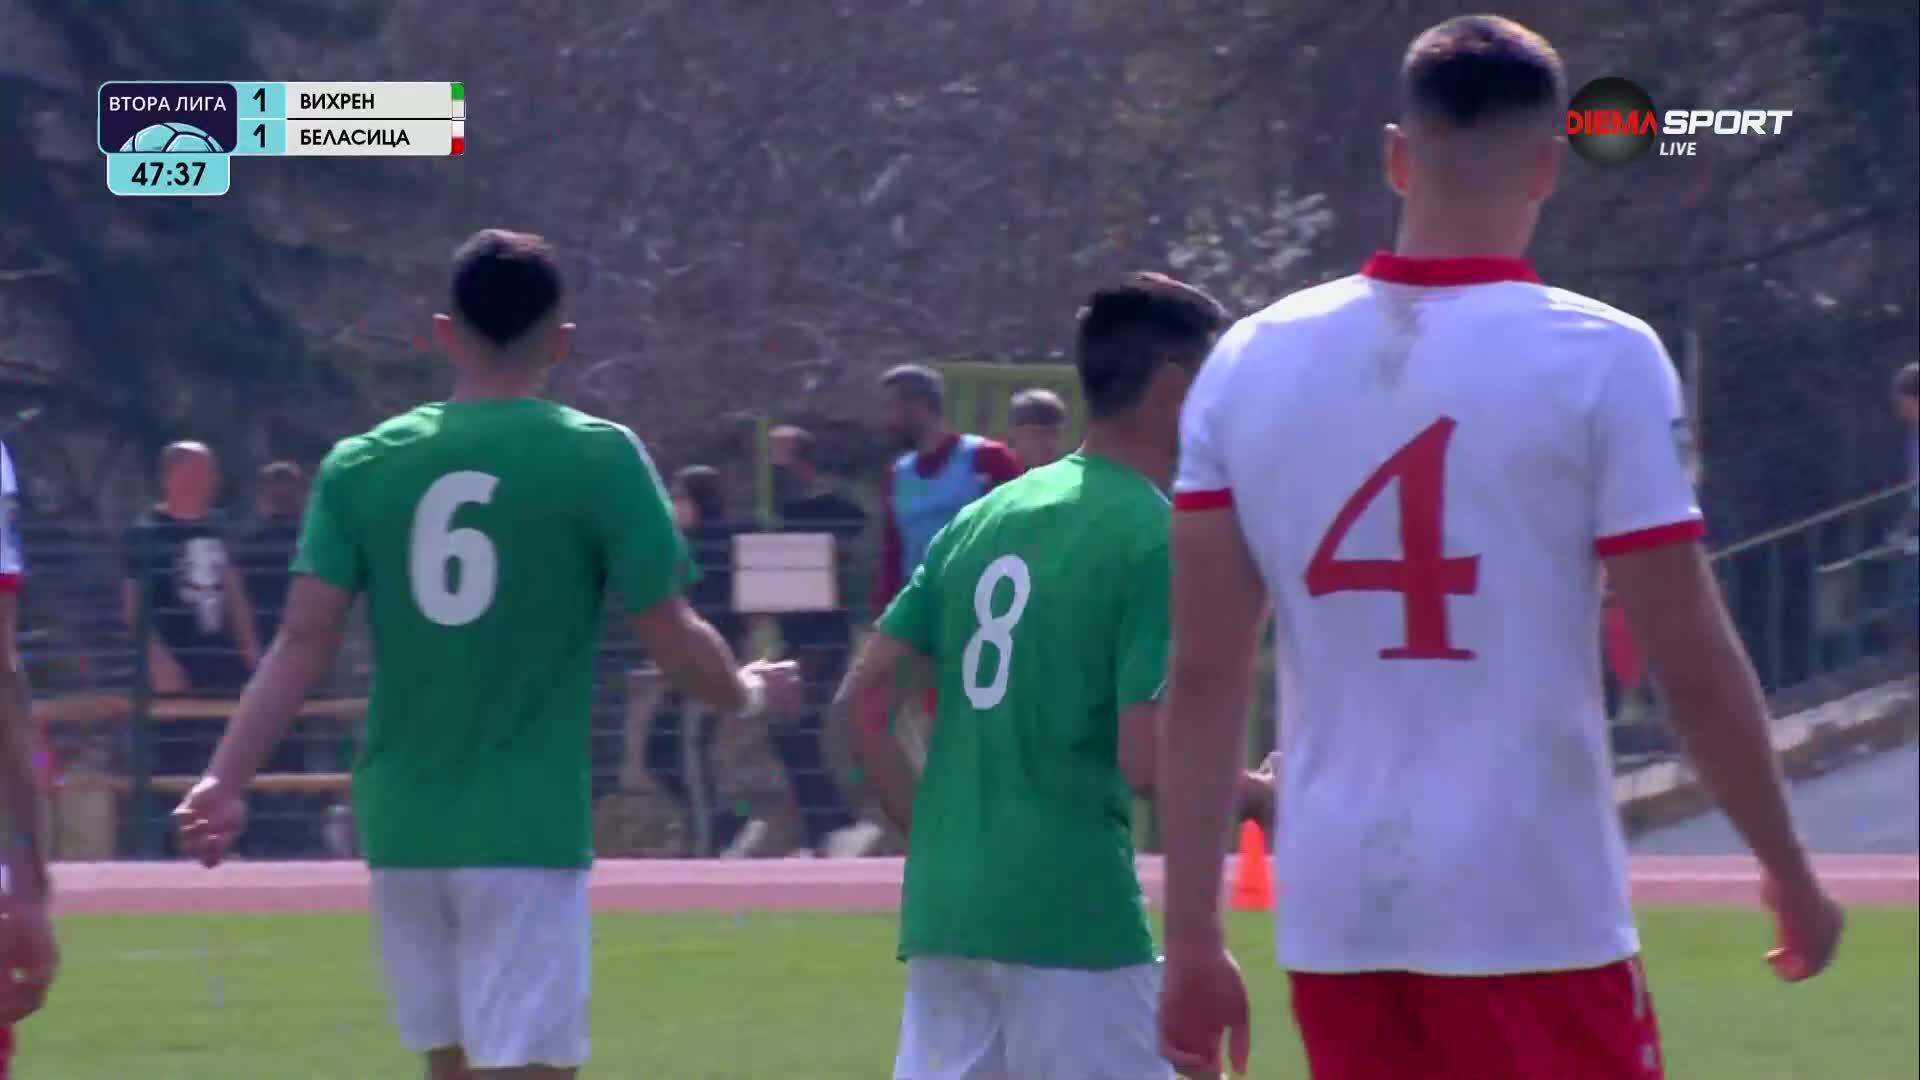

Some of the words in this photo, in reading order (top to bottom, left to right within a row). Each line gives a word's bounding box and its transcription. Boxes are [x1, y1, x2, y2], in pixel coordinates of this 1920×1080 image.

[409, 470, 500, 626] 6
[1304, 416, 1479, 661] 4
[962, 554, 1031, 711] 8
